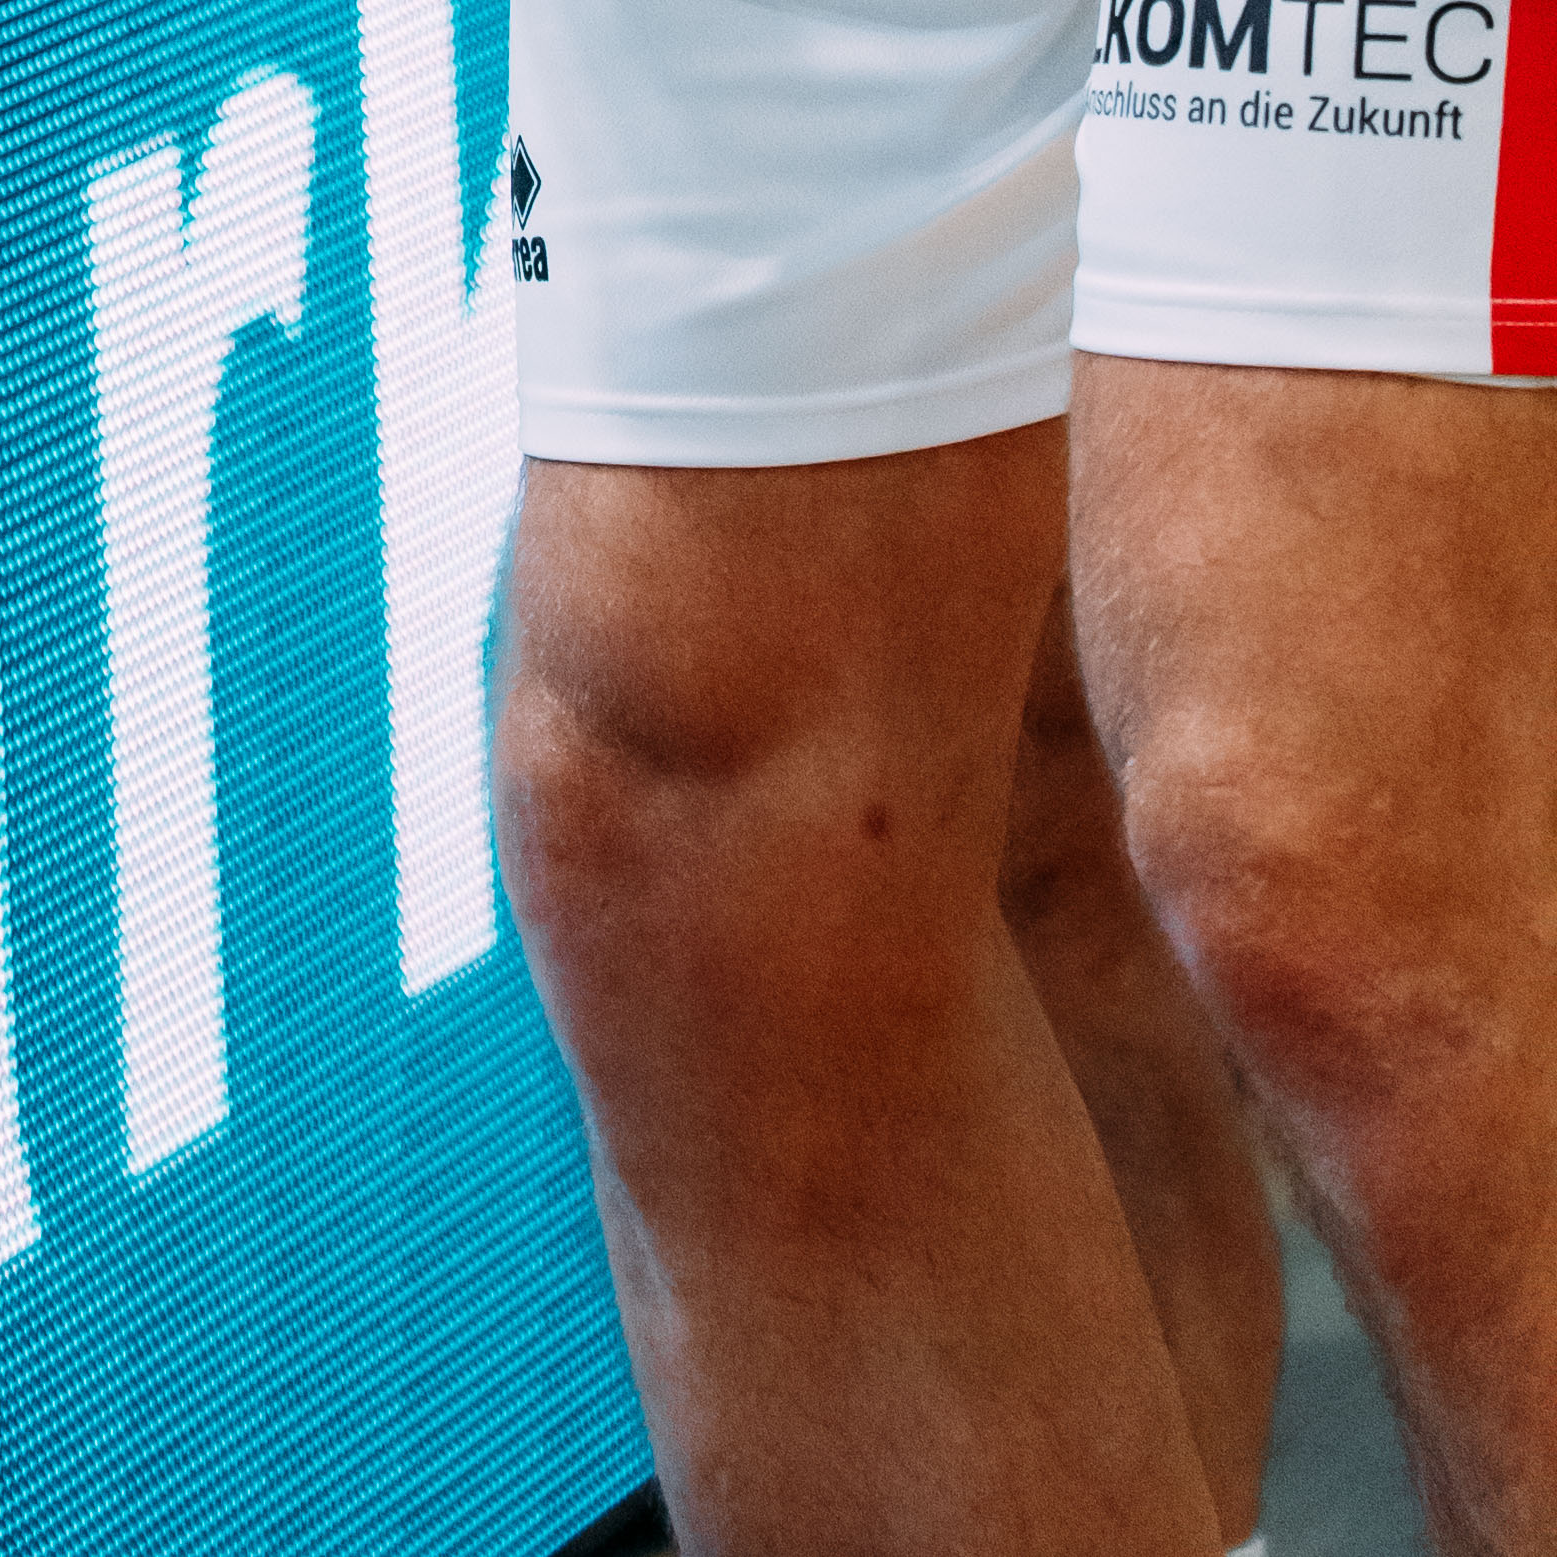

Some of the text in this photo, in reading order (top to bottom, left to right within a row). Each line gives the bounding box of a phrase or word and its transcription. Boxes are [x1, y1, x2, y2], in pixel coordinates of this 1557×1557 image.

[1188, 95, 1227, 125] an
[1240, 90, 1294, 130] die
[1307, 96, 1464, 140] Zukunft
